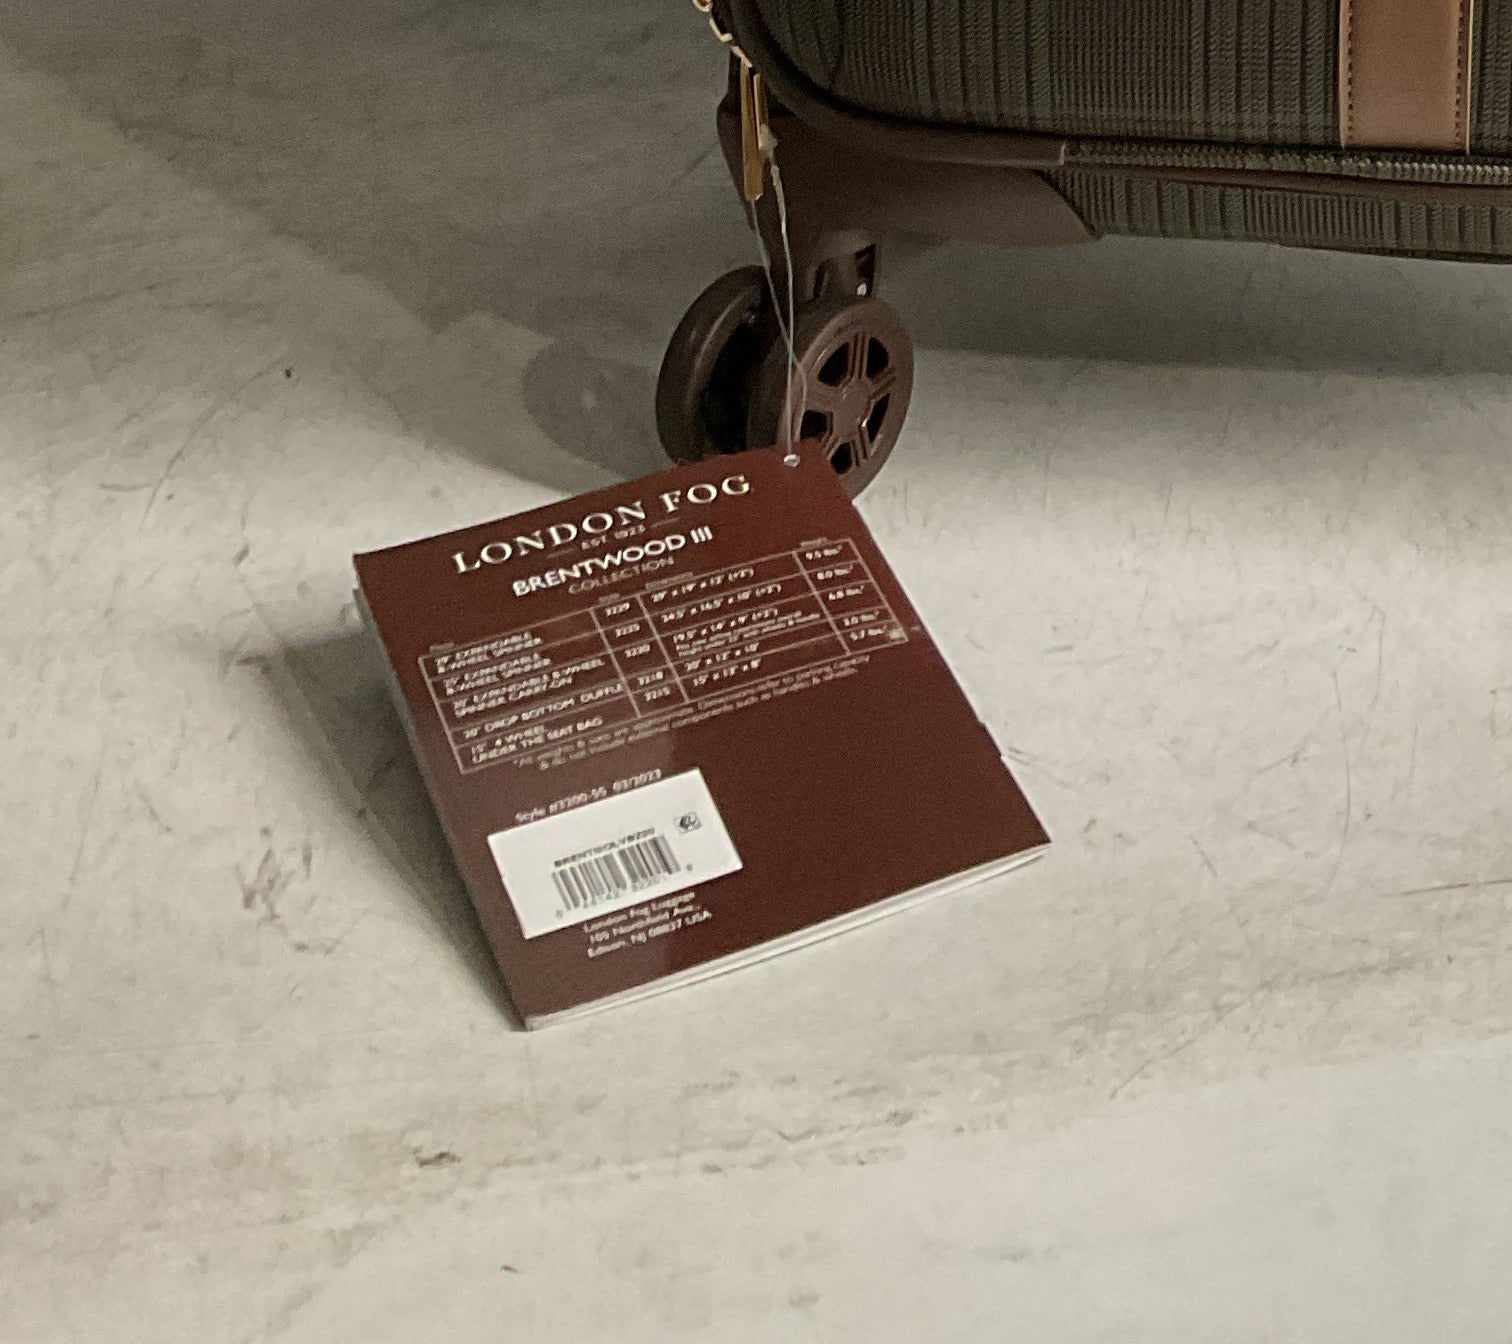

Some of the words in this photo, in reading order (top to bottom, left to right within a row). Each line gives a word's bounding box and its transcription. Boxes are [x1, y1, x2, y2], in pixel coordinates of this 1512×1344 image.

[452, 500, 645, 573] LONDON
[659, 475, 749, 512] FOG
[512, 534, 685, 596] BRENTWOOD
[690, 525, 712, 543] III
[567, 555, 674, 594] COLLECTION
